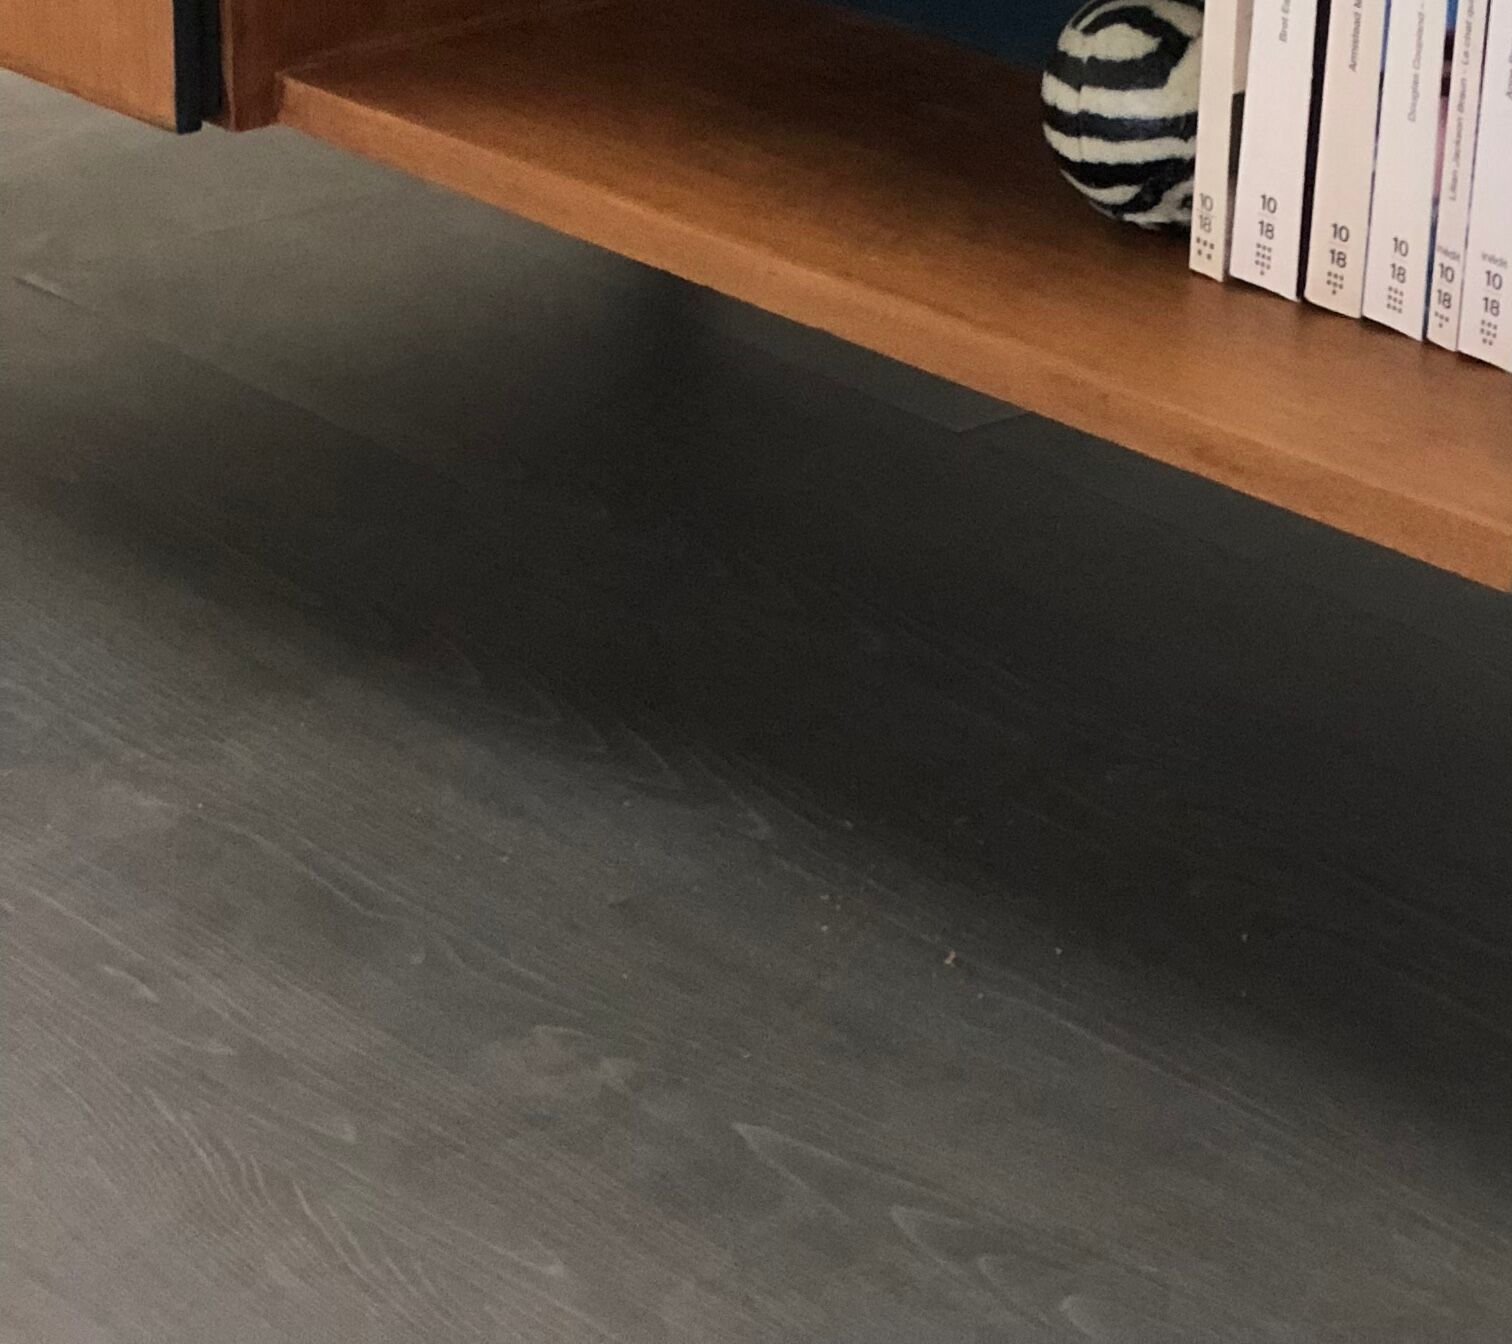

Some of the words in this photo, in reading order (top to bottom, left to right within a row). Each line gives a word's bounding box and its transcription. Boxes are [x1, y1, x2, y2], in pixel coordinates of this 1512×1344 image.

[1348, 11, 1362, 72] Armistead
[1199, 192, 1214, 212] 10
[1260, 193, 1278, 214] 10
[1199, 214, 1212, 233] 18
[1258, 220, 1275, 240] 18
[1331, 223, 1350, 242] 10
[1393, 236, 1410, 257] 10
[1329, 249, 1347, 269] 18
[1390, 263, 1407, 284] 18
[1438, 263, 1455, 283] 10
[1485, 270, 1503, 290] 10
[1437, 289, 1453, 310] 18
[1483, 297, 1501, 317] 18
